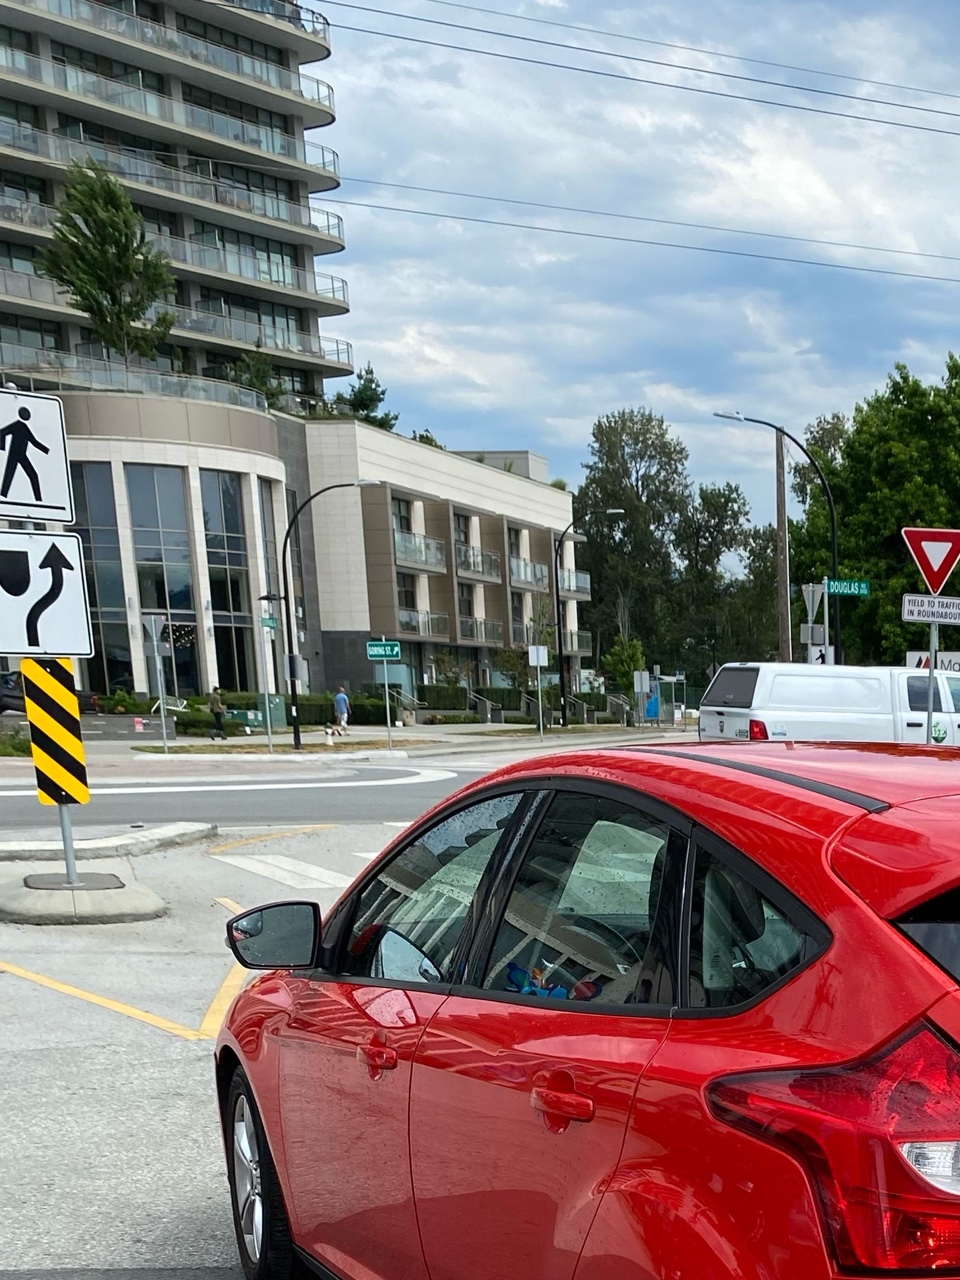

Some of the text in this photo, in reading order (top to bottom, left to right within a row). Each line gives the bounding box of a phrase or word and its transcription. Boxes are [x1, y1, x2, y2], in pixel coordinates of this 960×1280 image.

[830, 581, 859, 594] DOUGLAS
[907, 598, 960, 610] YIELD TO TRAFFIC
[907, 609, 960, 620] IN ROUNDABOUT
